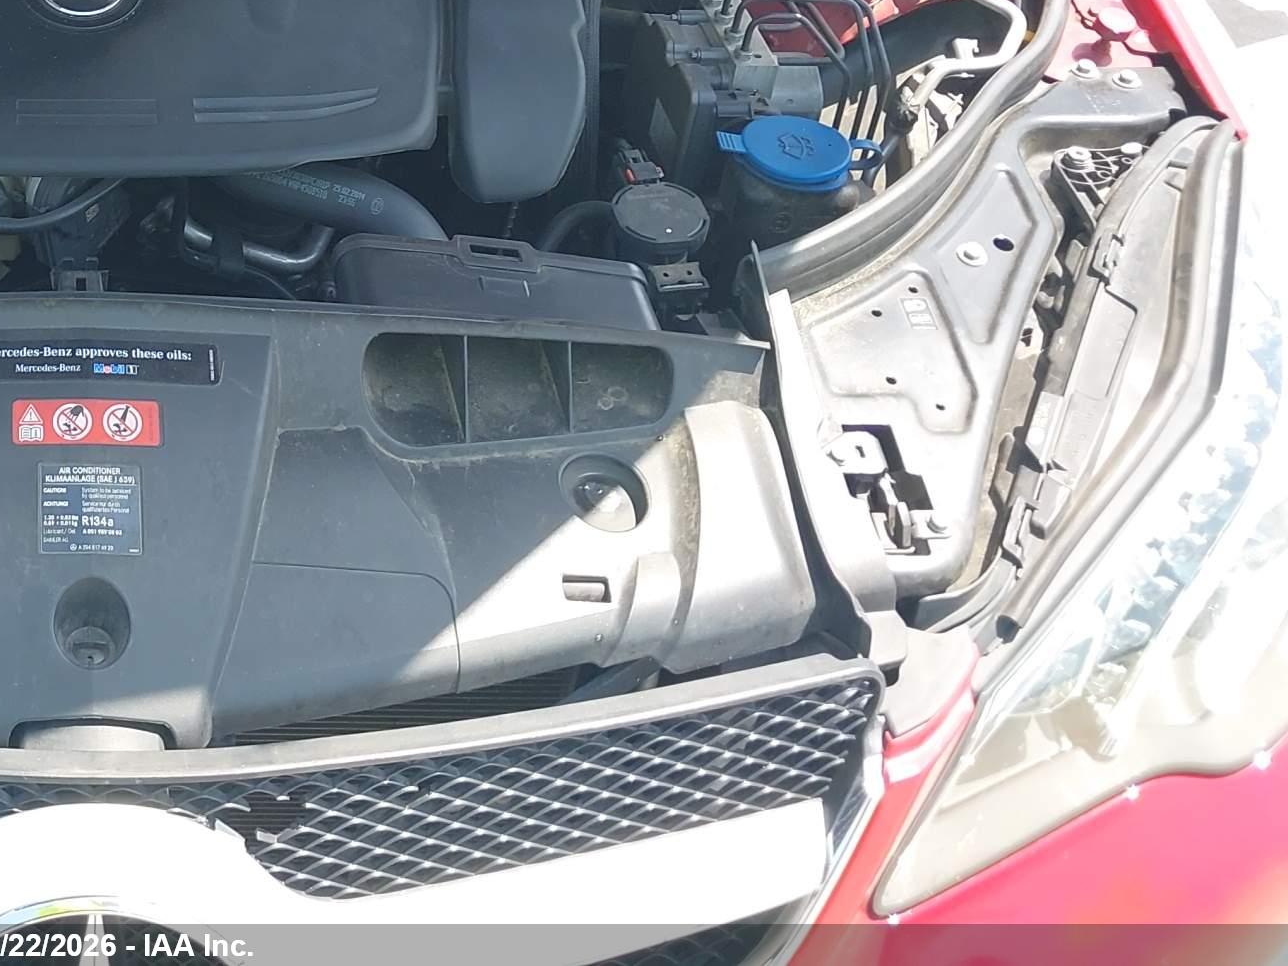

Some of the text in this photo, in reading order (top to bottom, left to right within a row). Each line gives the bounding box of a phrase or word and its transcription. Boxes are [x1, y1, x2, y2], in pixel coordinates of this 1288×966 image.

[75, 348, 128, 360] approves
[132, 349, 164, 360] these
[166, 350, 193, 361] oils:
[15, 364, 81, 372] Mercedes-Benz
[93, 363, 125, 375] Mobil
[45, 475, 95, 483] KLIMAANLAGE
[81, 515, 113, 526] R134a
